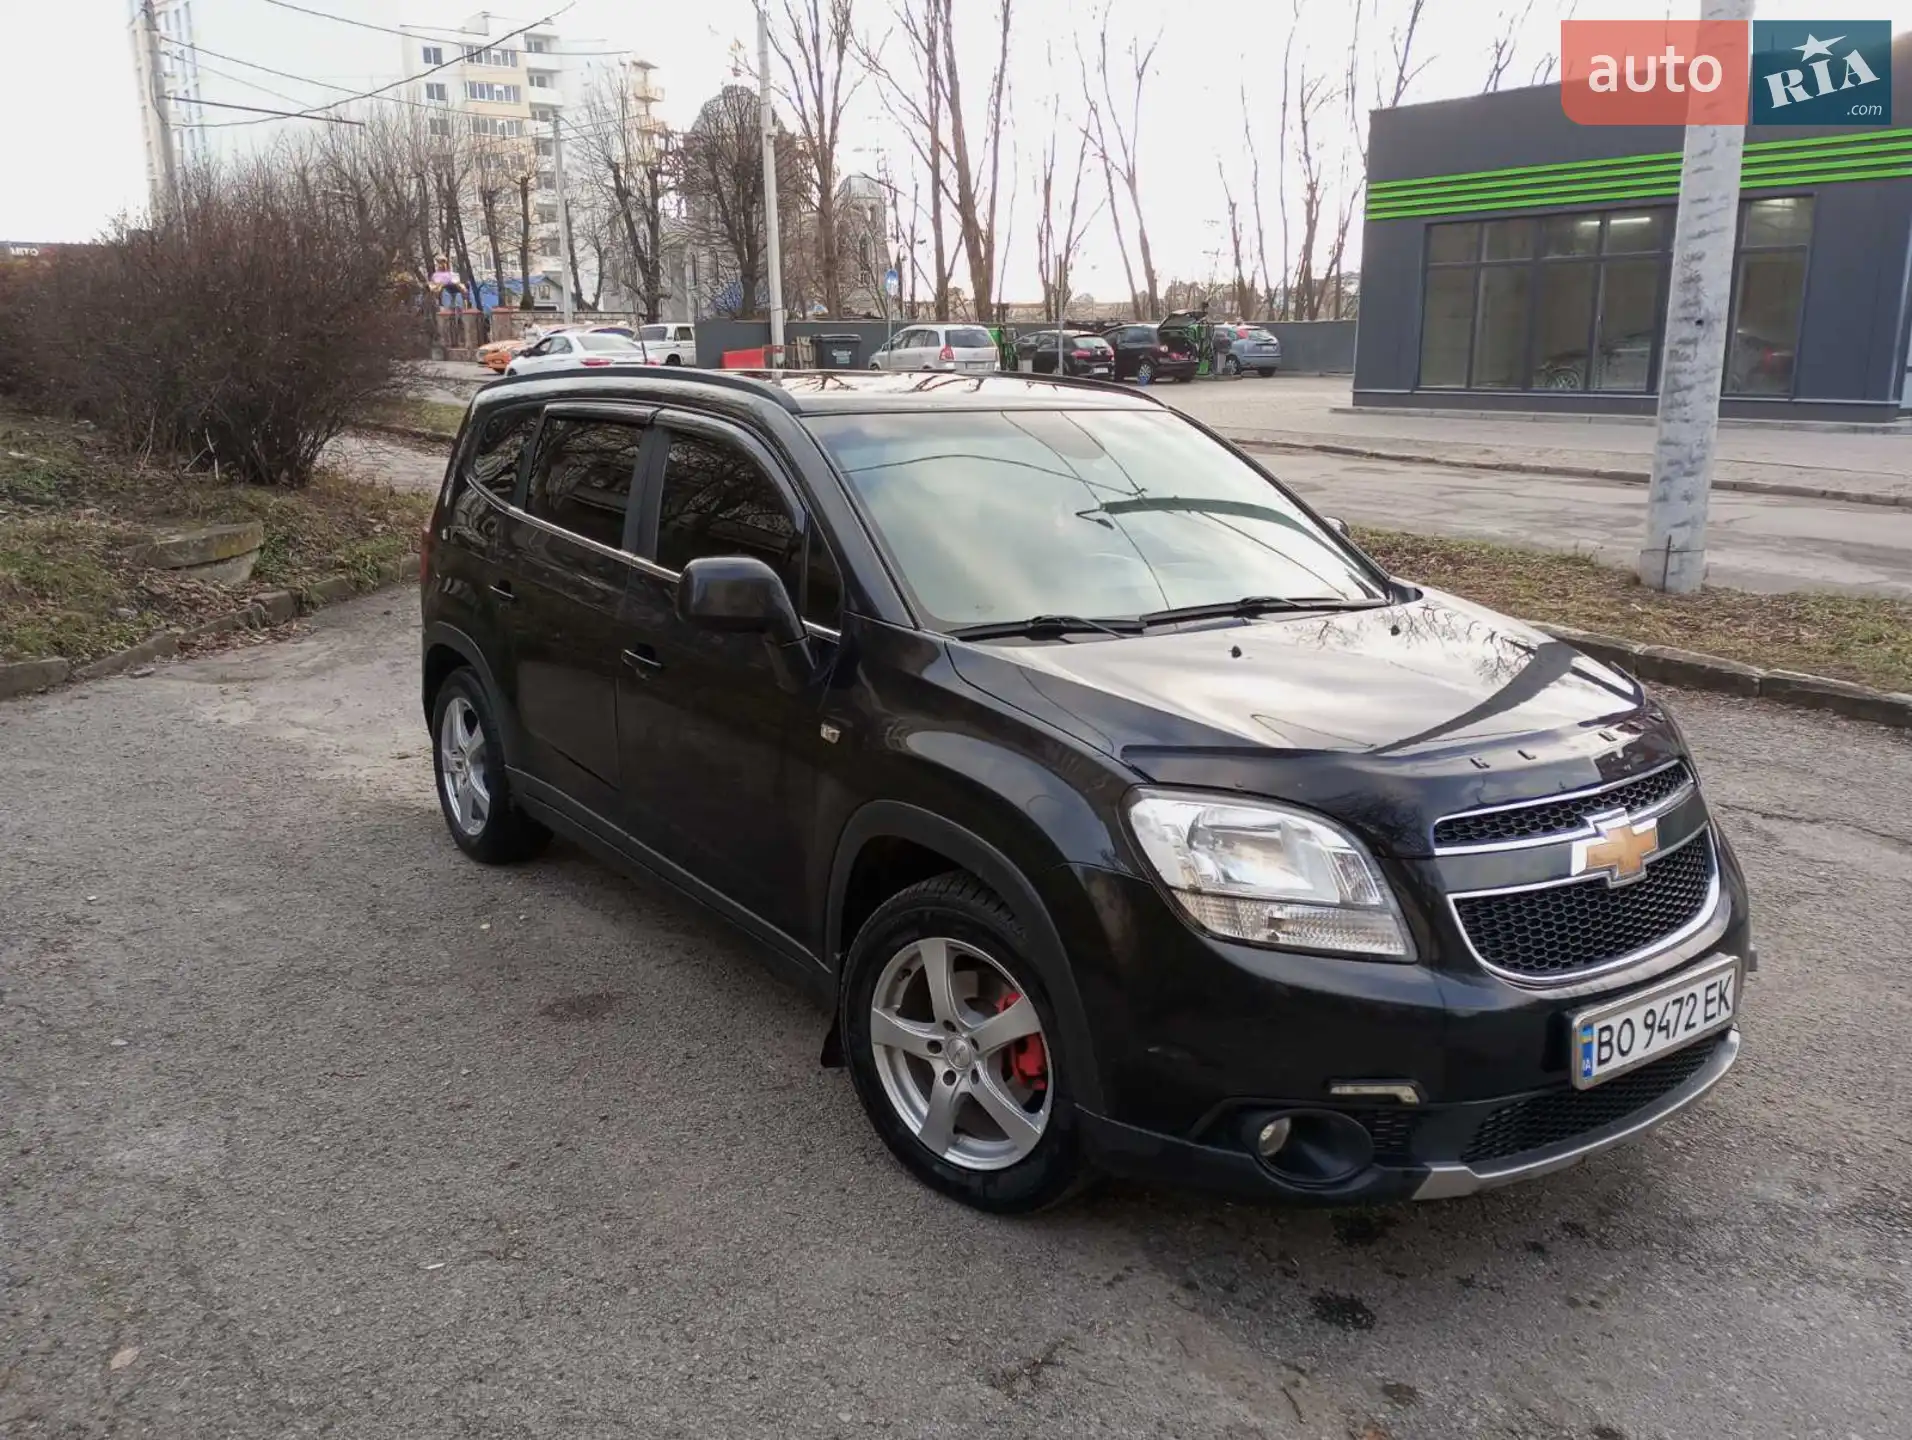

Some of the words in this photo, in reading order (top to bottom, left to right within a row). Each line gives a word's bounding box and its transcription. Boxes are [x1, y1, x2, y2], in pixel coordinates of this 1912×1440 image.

[1597, 1017, 1635, 1066] BO
[1643, 992, 1698, 1050] 9472
[1703, 974, 1733, 1024] EK
